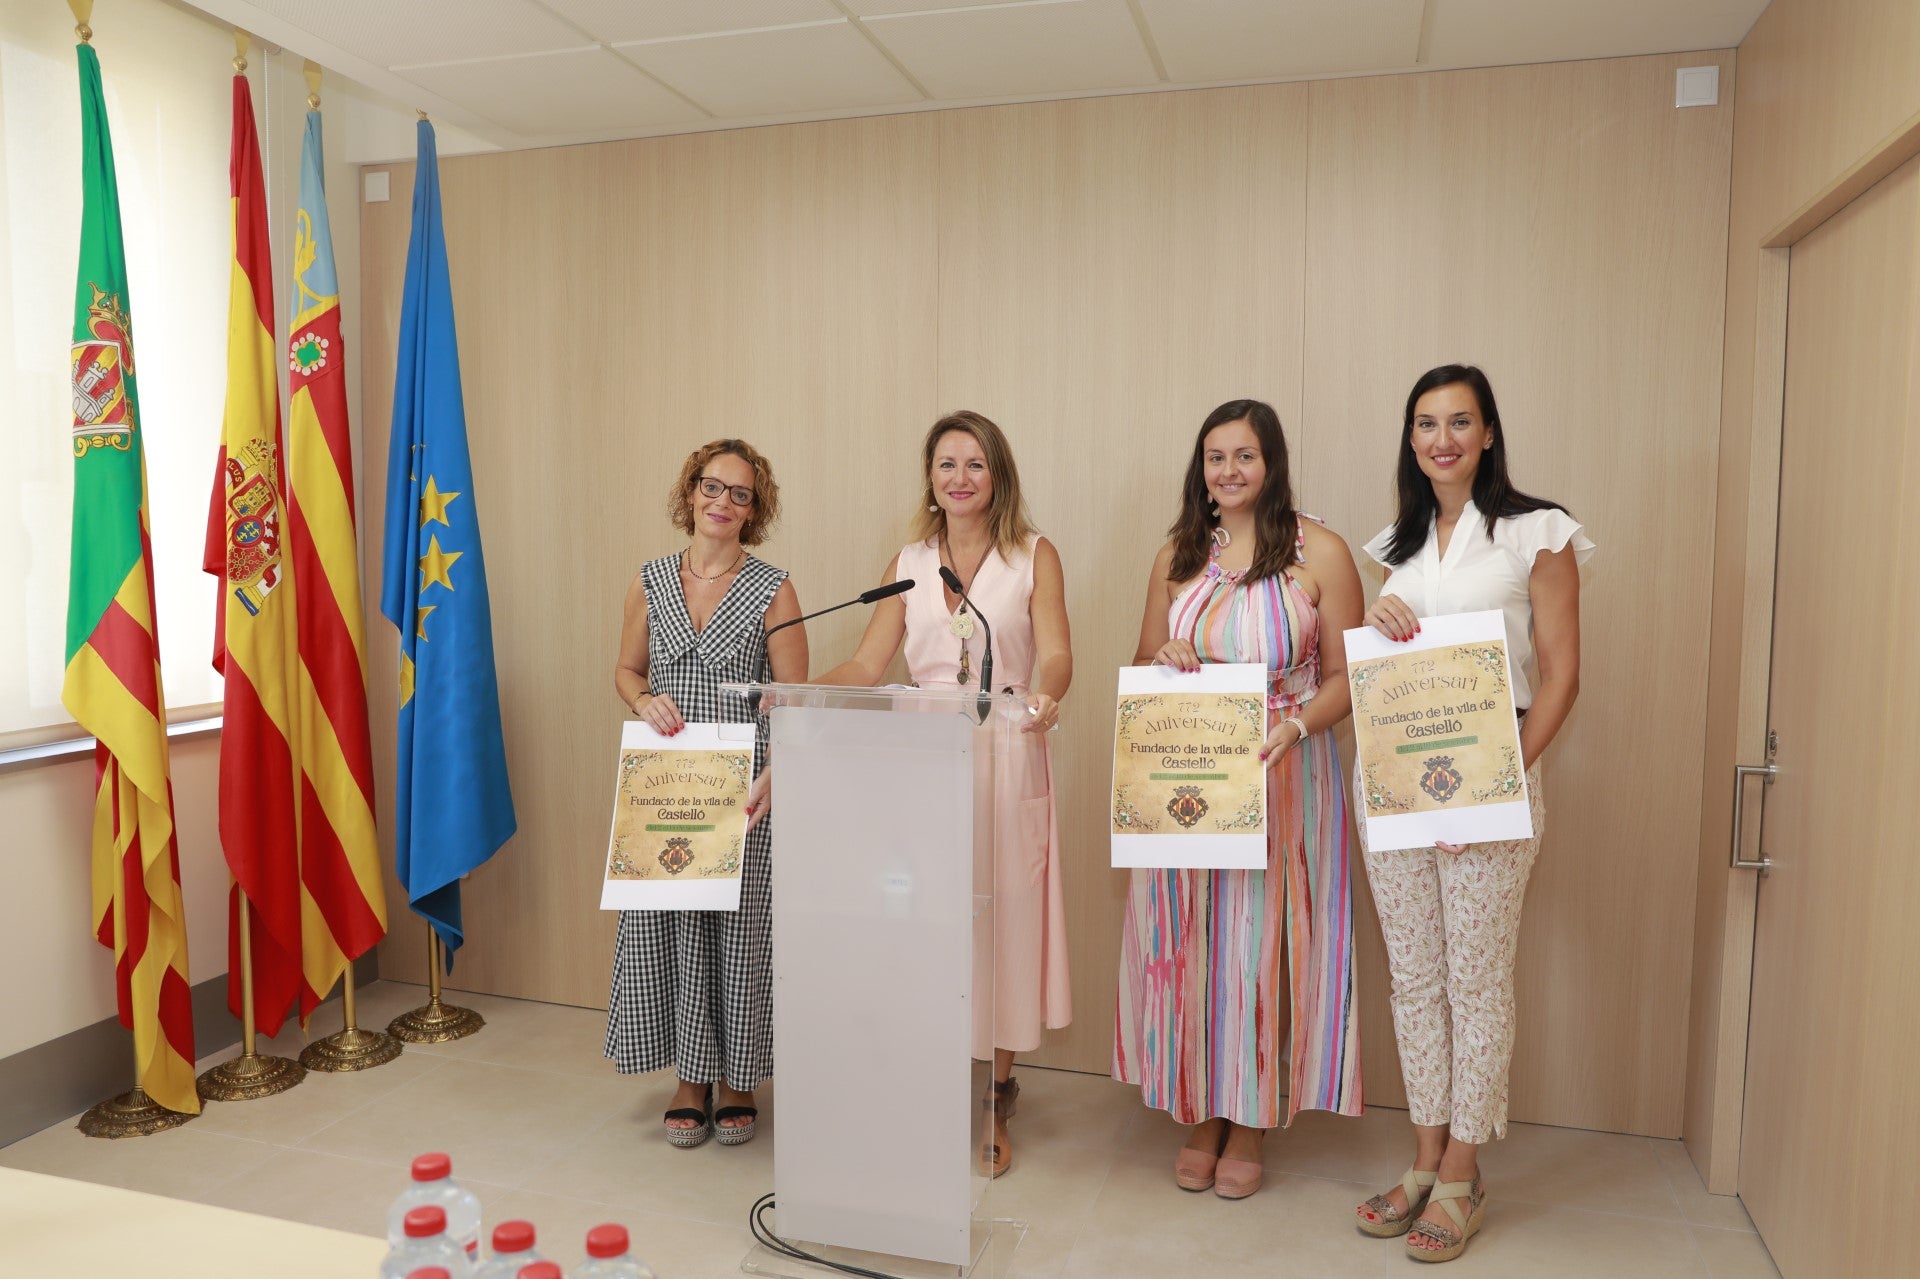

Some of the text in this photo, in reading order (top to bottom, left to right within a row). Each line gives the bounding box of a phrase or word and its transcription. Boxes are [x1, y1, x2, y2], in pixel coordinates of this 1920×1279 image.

[1411, 660, 1435, 674] 772
[1178, 702, 1200, 713] 772
[1371, 699, 1495, 726] Fundació de la vila de
[1406, 720, 1462, 738] Castelló
[1131, 743, 1249, 755] Fundació de la vila de
[676, 759, 695, 768] 772
[1162, 757, 1215, 769] Castelló
[631, 796, 735, 806] Fundació de la vila de
[658, 809, 705, 820] Castelló
